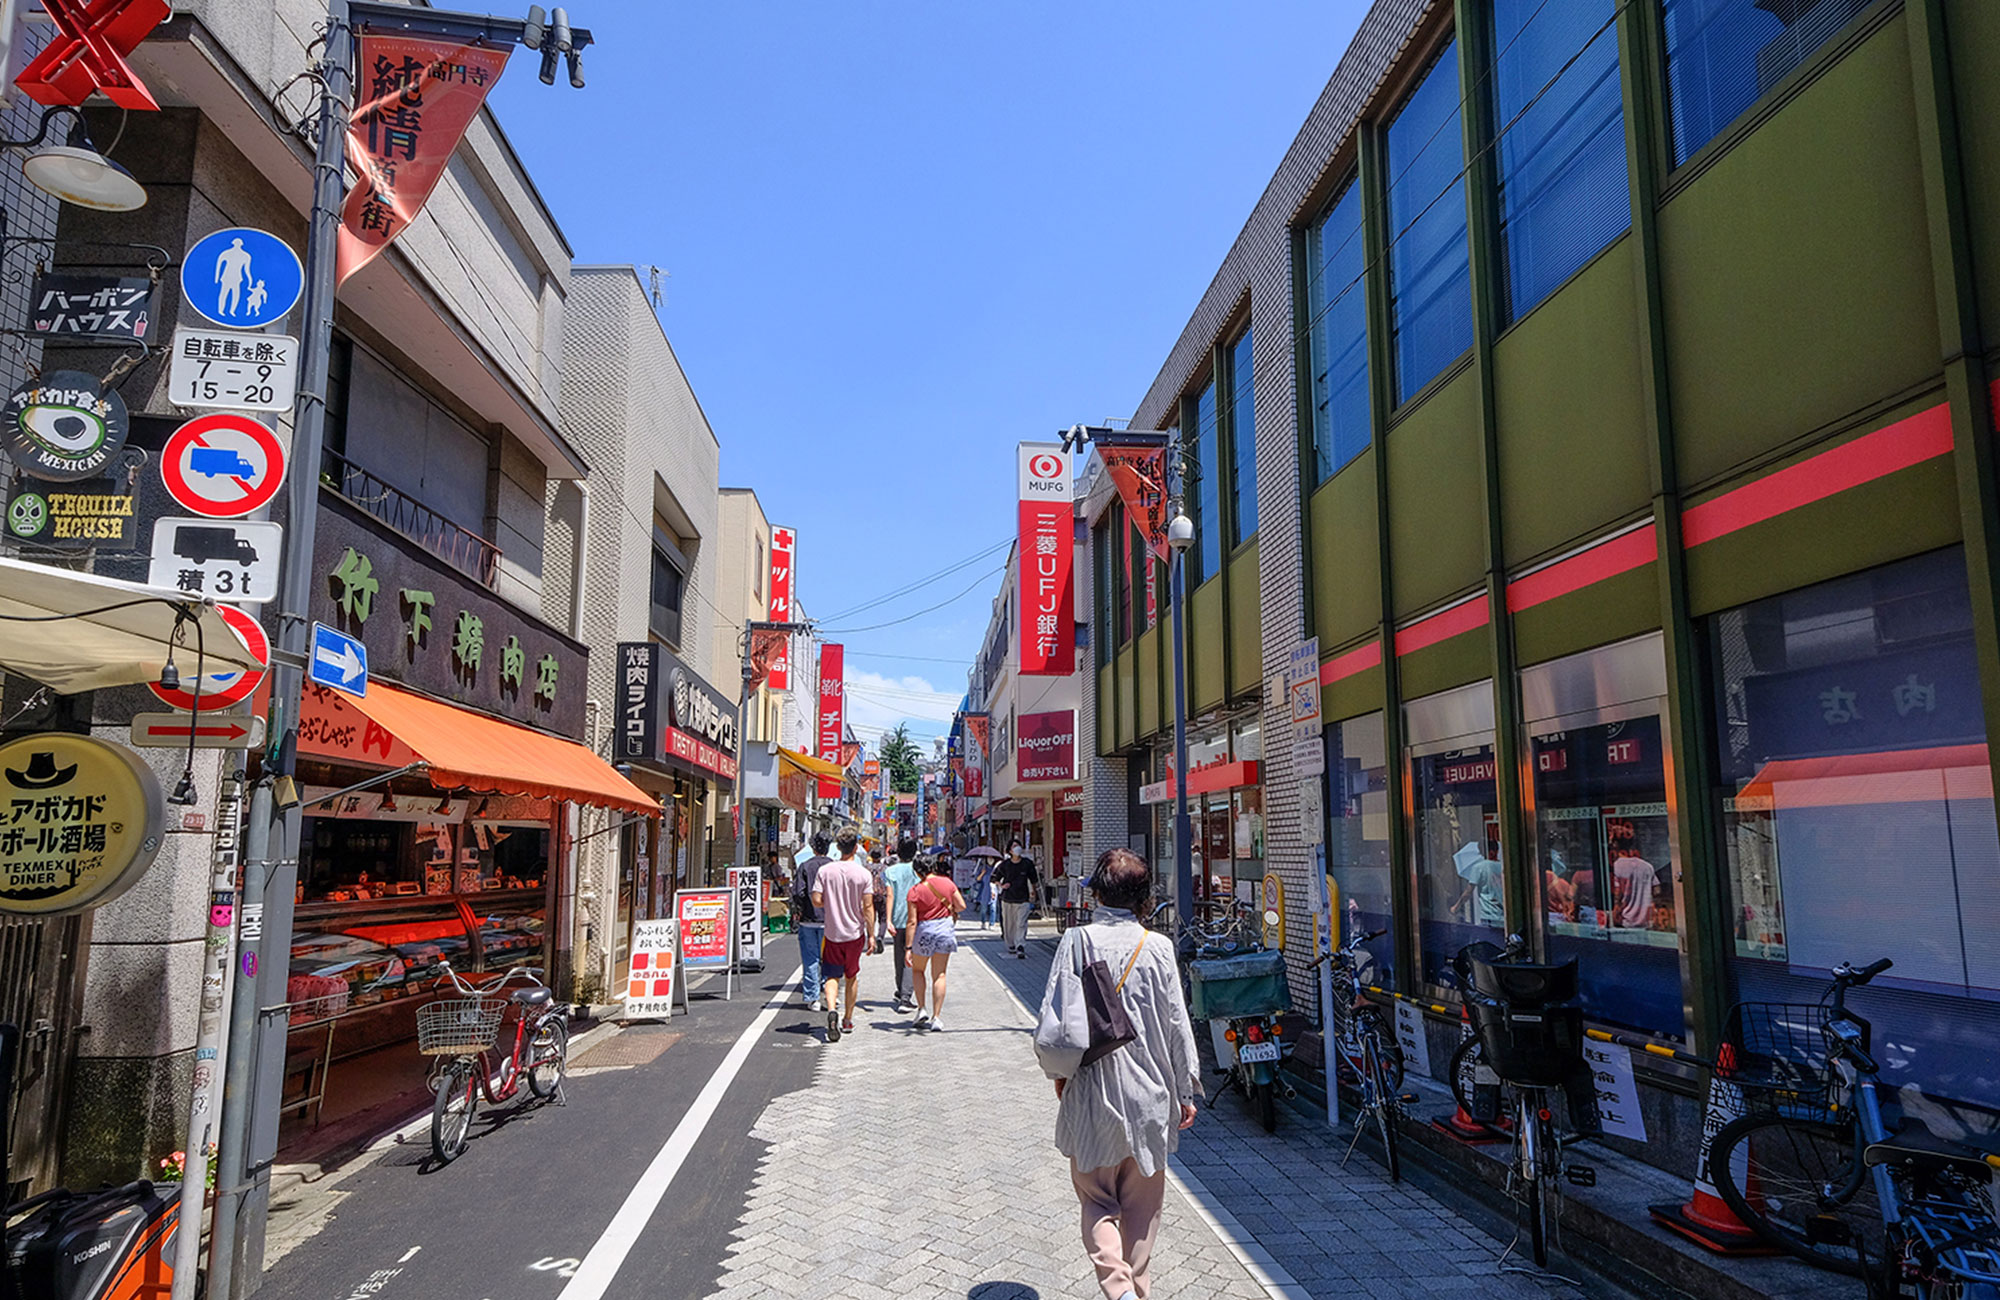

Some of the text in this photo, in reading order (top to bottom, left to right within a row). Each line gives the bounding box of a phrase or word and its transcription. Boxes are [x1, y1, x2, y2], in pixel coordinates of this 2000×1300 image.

[427, 58, 489, 87] 高円寺
[39, 287, 149, 310] バーボン
[50, 310, 132, 333] ハウス
[184, 337, 287, 363] 自転車を除く
[37, 451, 107, 472] MEXICAN
[1028, 481, 1064, 492] MUFG
[49, 494, 133, 516] TEQUILA
[53, 517, 123, 539] HOUSE
[1036, 513, 1059, 657] 三菱UFJ銀行
[328, 546, 560, 701] 竹下精肉店
[770, 565, 789, 673] ツル局
[626, 646, 649, 737] 焼肉ライク
[1018, 733, 1073, 749] Liquor OFF
[1022, 766, 1069, 778] お売り下さい
[0, 824, 106, 857] ボール酒場
[3, 860, 64, 874] TEXMEX
[10, 872, 56, 886] DINER
[739, 870, 758, 946] 焼肉ライク
[73, 1239, 111, 1264] KOSHIN
